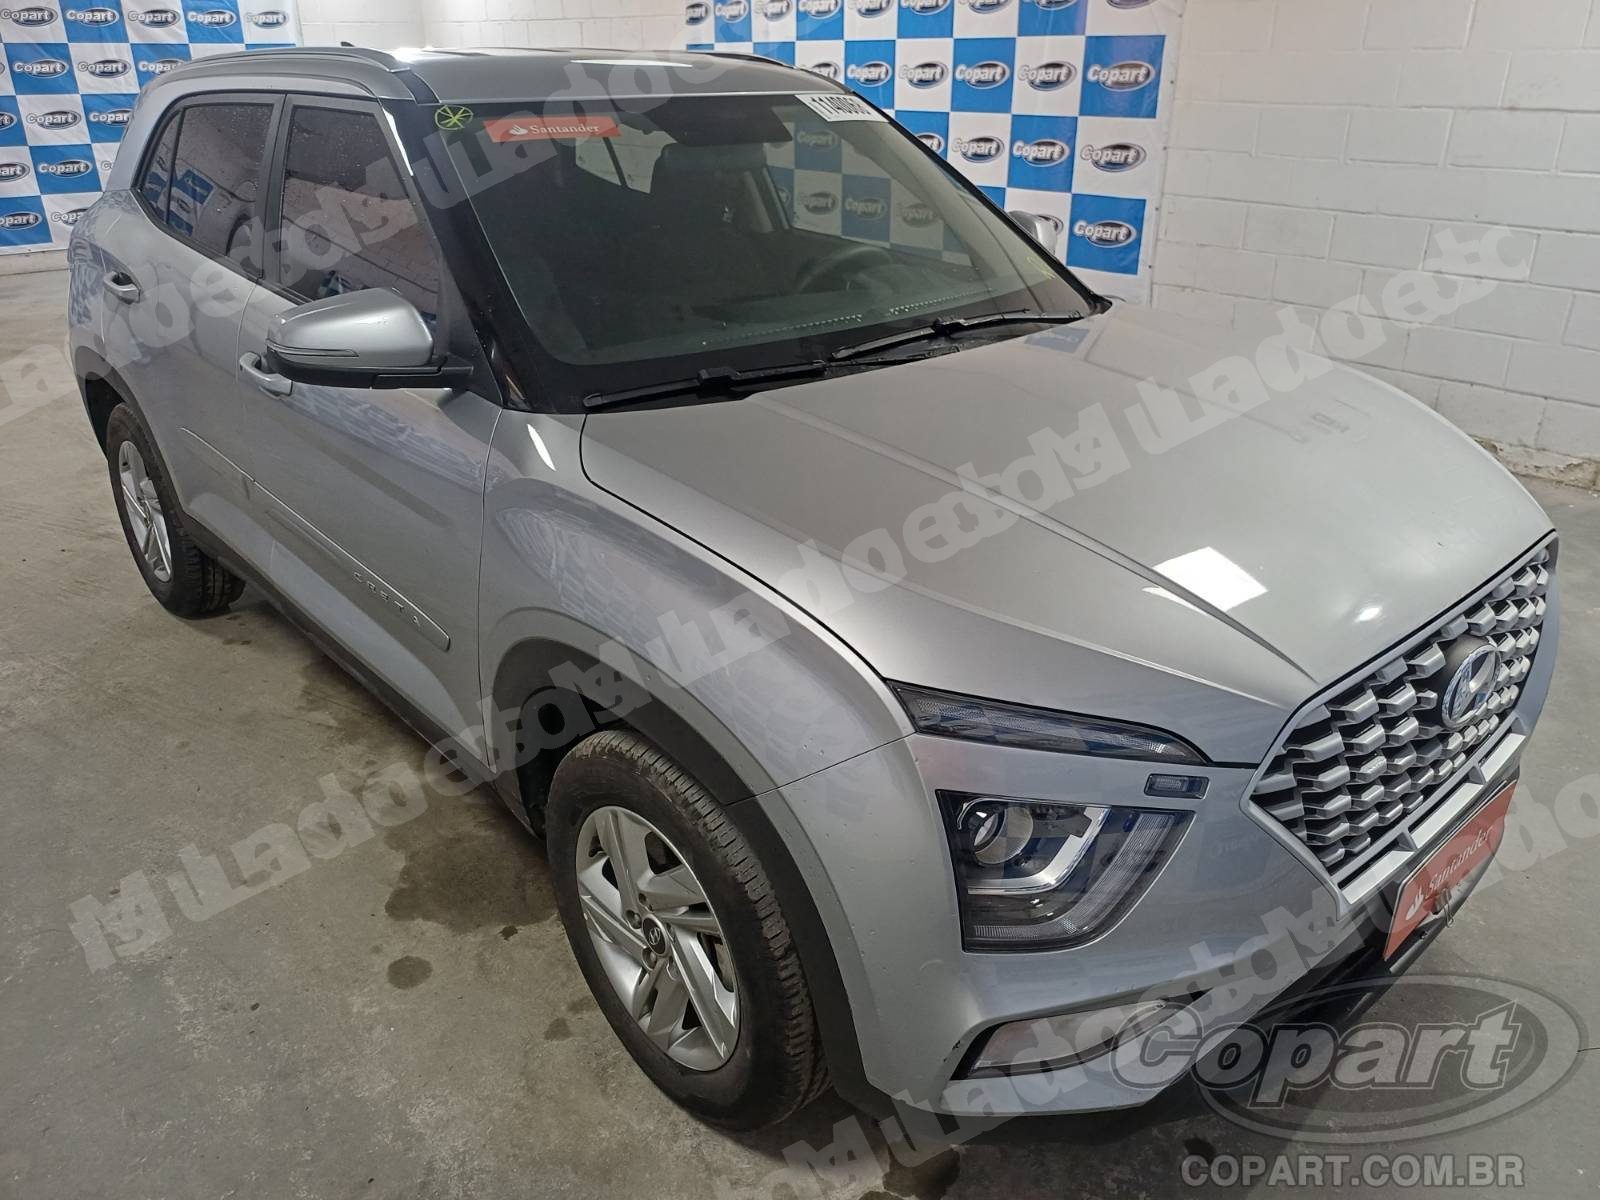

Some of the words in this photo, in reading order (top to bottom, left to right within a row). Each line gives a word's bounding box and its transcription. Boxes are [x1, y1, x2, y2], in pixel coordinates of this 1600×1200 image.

[1, 9, 49, 23] Copart
[66, 10, 114, 23] Copart
[128, 10, 173, 24] Copart
[187, 11, 232, 25] Copart
[14, 61, 61, 75] Copart
[78, 61, 124, 75] Copart
[847, 64, 886, 81] Copart
[900, 65, 942, 82] Copart
[955, 64, 1003, 83] Copart
[1018, 65, 1067, 82] Copart
[1087, 64, 1146, 85] Copart
[26, 113, 74, 126] Copart
[89, 112, 130, 125] Copar
[530, 124, 600, 135] Santander
[952, 138, 997, 157] Copart
[1012, 140, 1062, 160] Copart
[1080, 145, 1137, 164] Copart
[39, 163, 86, 176] Copart
[0, 215, 36, 227] opart
[52, 211, 81, 225] Copa
[1074, 220, 1128, 241] Copart
[1429, 824, 1494, 891] Santander
